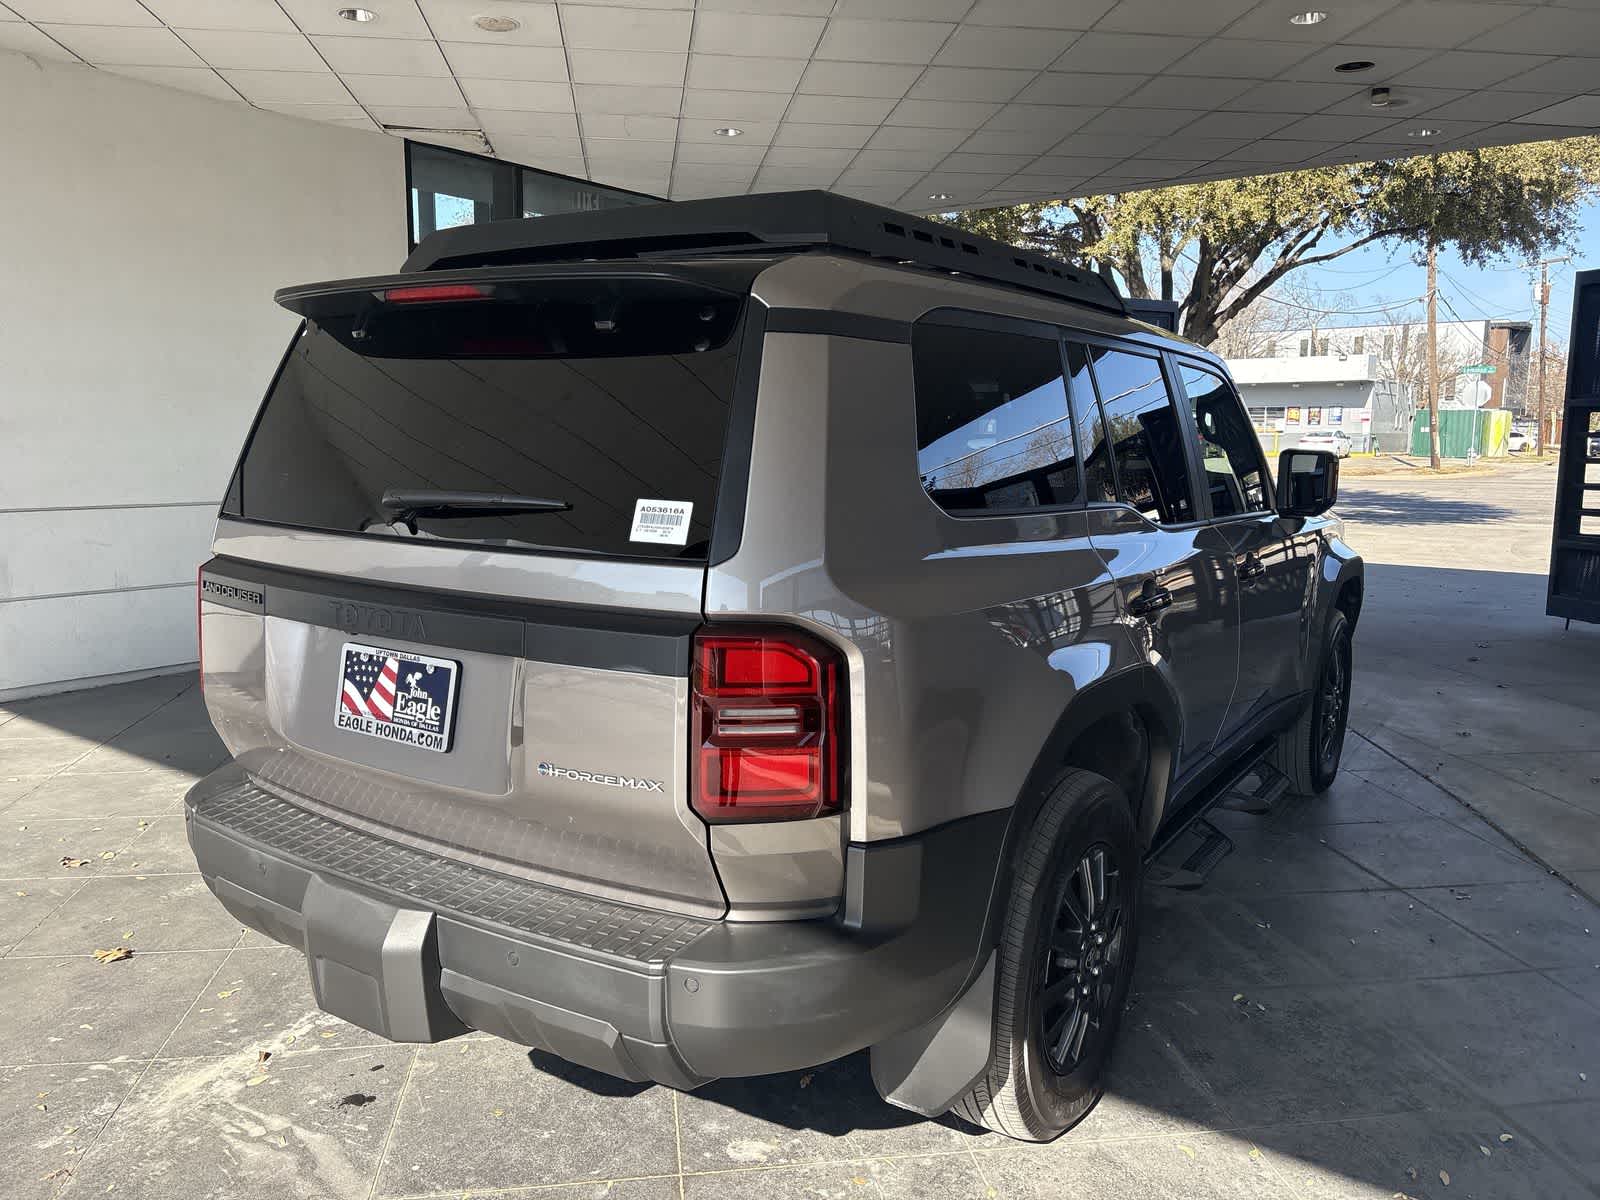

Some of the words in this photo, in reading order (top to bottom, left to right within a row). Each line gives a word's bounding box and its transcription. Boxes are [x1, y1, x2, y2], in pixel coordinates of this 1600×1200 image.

[331, 601, 426, 640] TOYOTA
[375, 649, 398, 660] UPTOWN
[399, 653, 421, 662] DALLAS
[408, 686, 428, 699] John
[394, 691, 441, 722] Eagle
[338, 714, 373, 732] EAGLE
[375, 723, 443, 750] HONDA.COM
[418, 722, 440, 732] DALLAS
